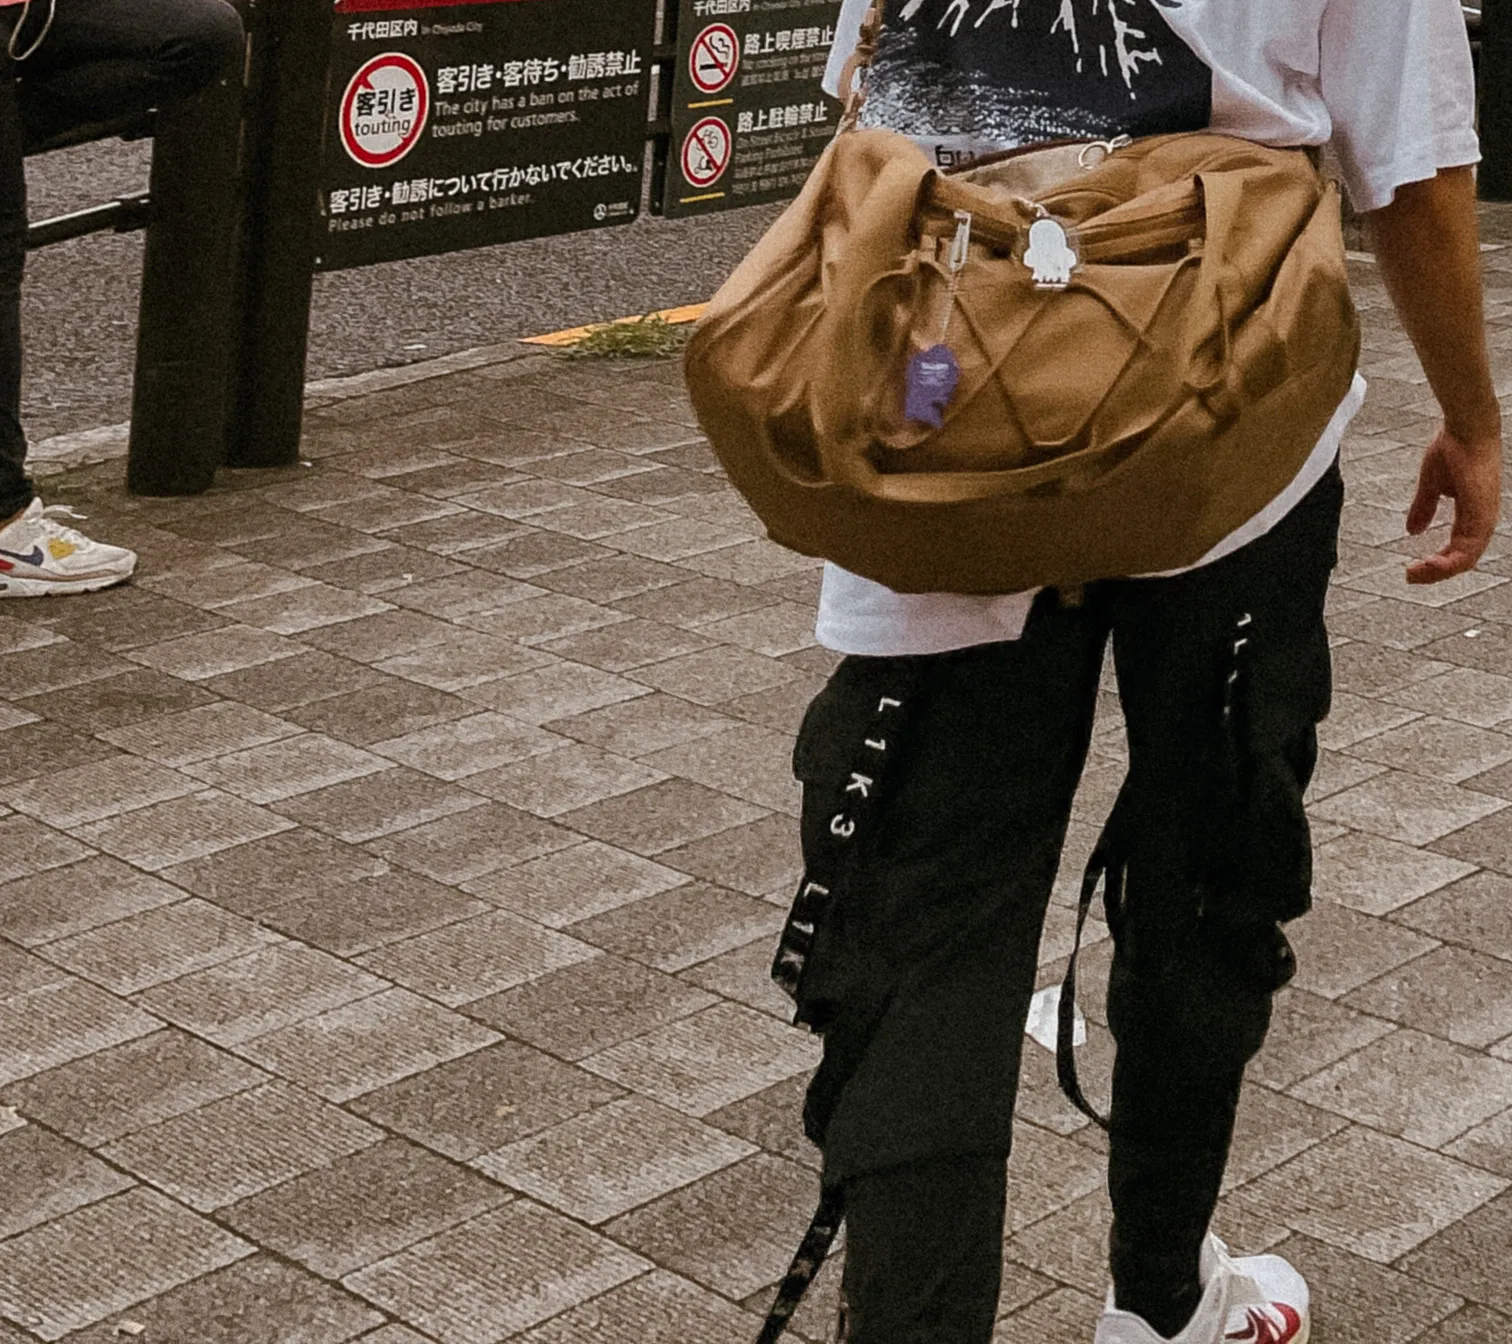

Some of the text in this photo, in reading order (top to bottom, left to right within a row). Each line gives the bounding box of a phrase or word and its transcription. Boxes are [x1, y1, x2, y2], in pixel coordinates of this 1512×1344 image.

[347, 19, 418, 42] 千代田区内
[356, 88, 416, 117] 客引き
[434, 80, 640, 116] The city has a ban on the act of
[355, 116, 411, 138] touting
[432, 108, 581, 138] touting for customers.
[328, 216, 374, 233] Please
[378, 211, 397, 225] do
[401, 207, 426, 223] not
[429, 201, 473, 217] follow
[476, 201, 485, 211] a
